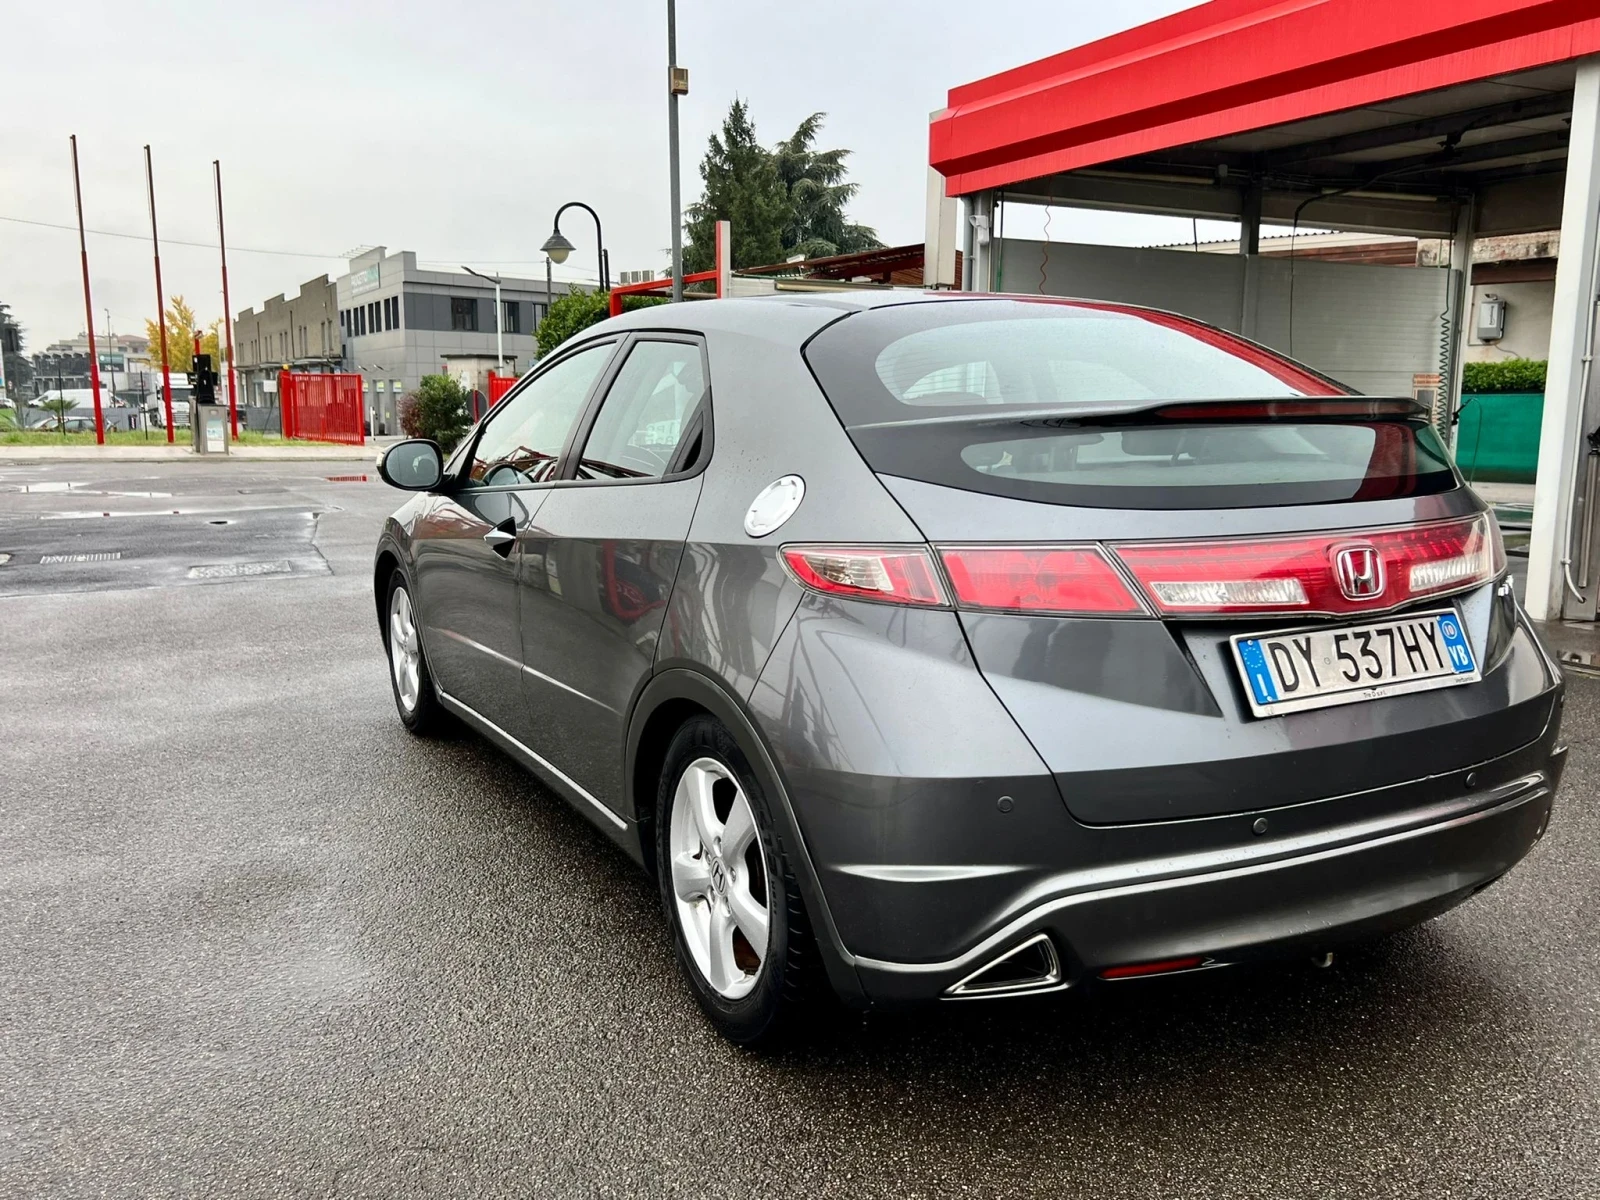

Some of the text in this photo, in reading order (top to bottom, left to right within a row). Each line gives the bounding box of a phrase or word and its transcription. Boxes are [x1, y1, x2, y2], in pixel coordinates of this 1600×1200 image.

[1267, 637, 1321, 692] DY
[1334, 621, 1444, 683] 537HY
[1447, 644, 1469, 666] VB
